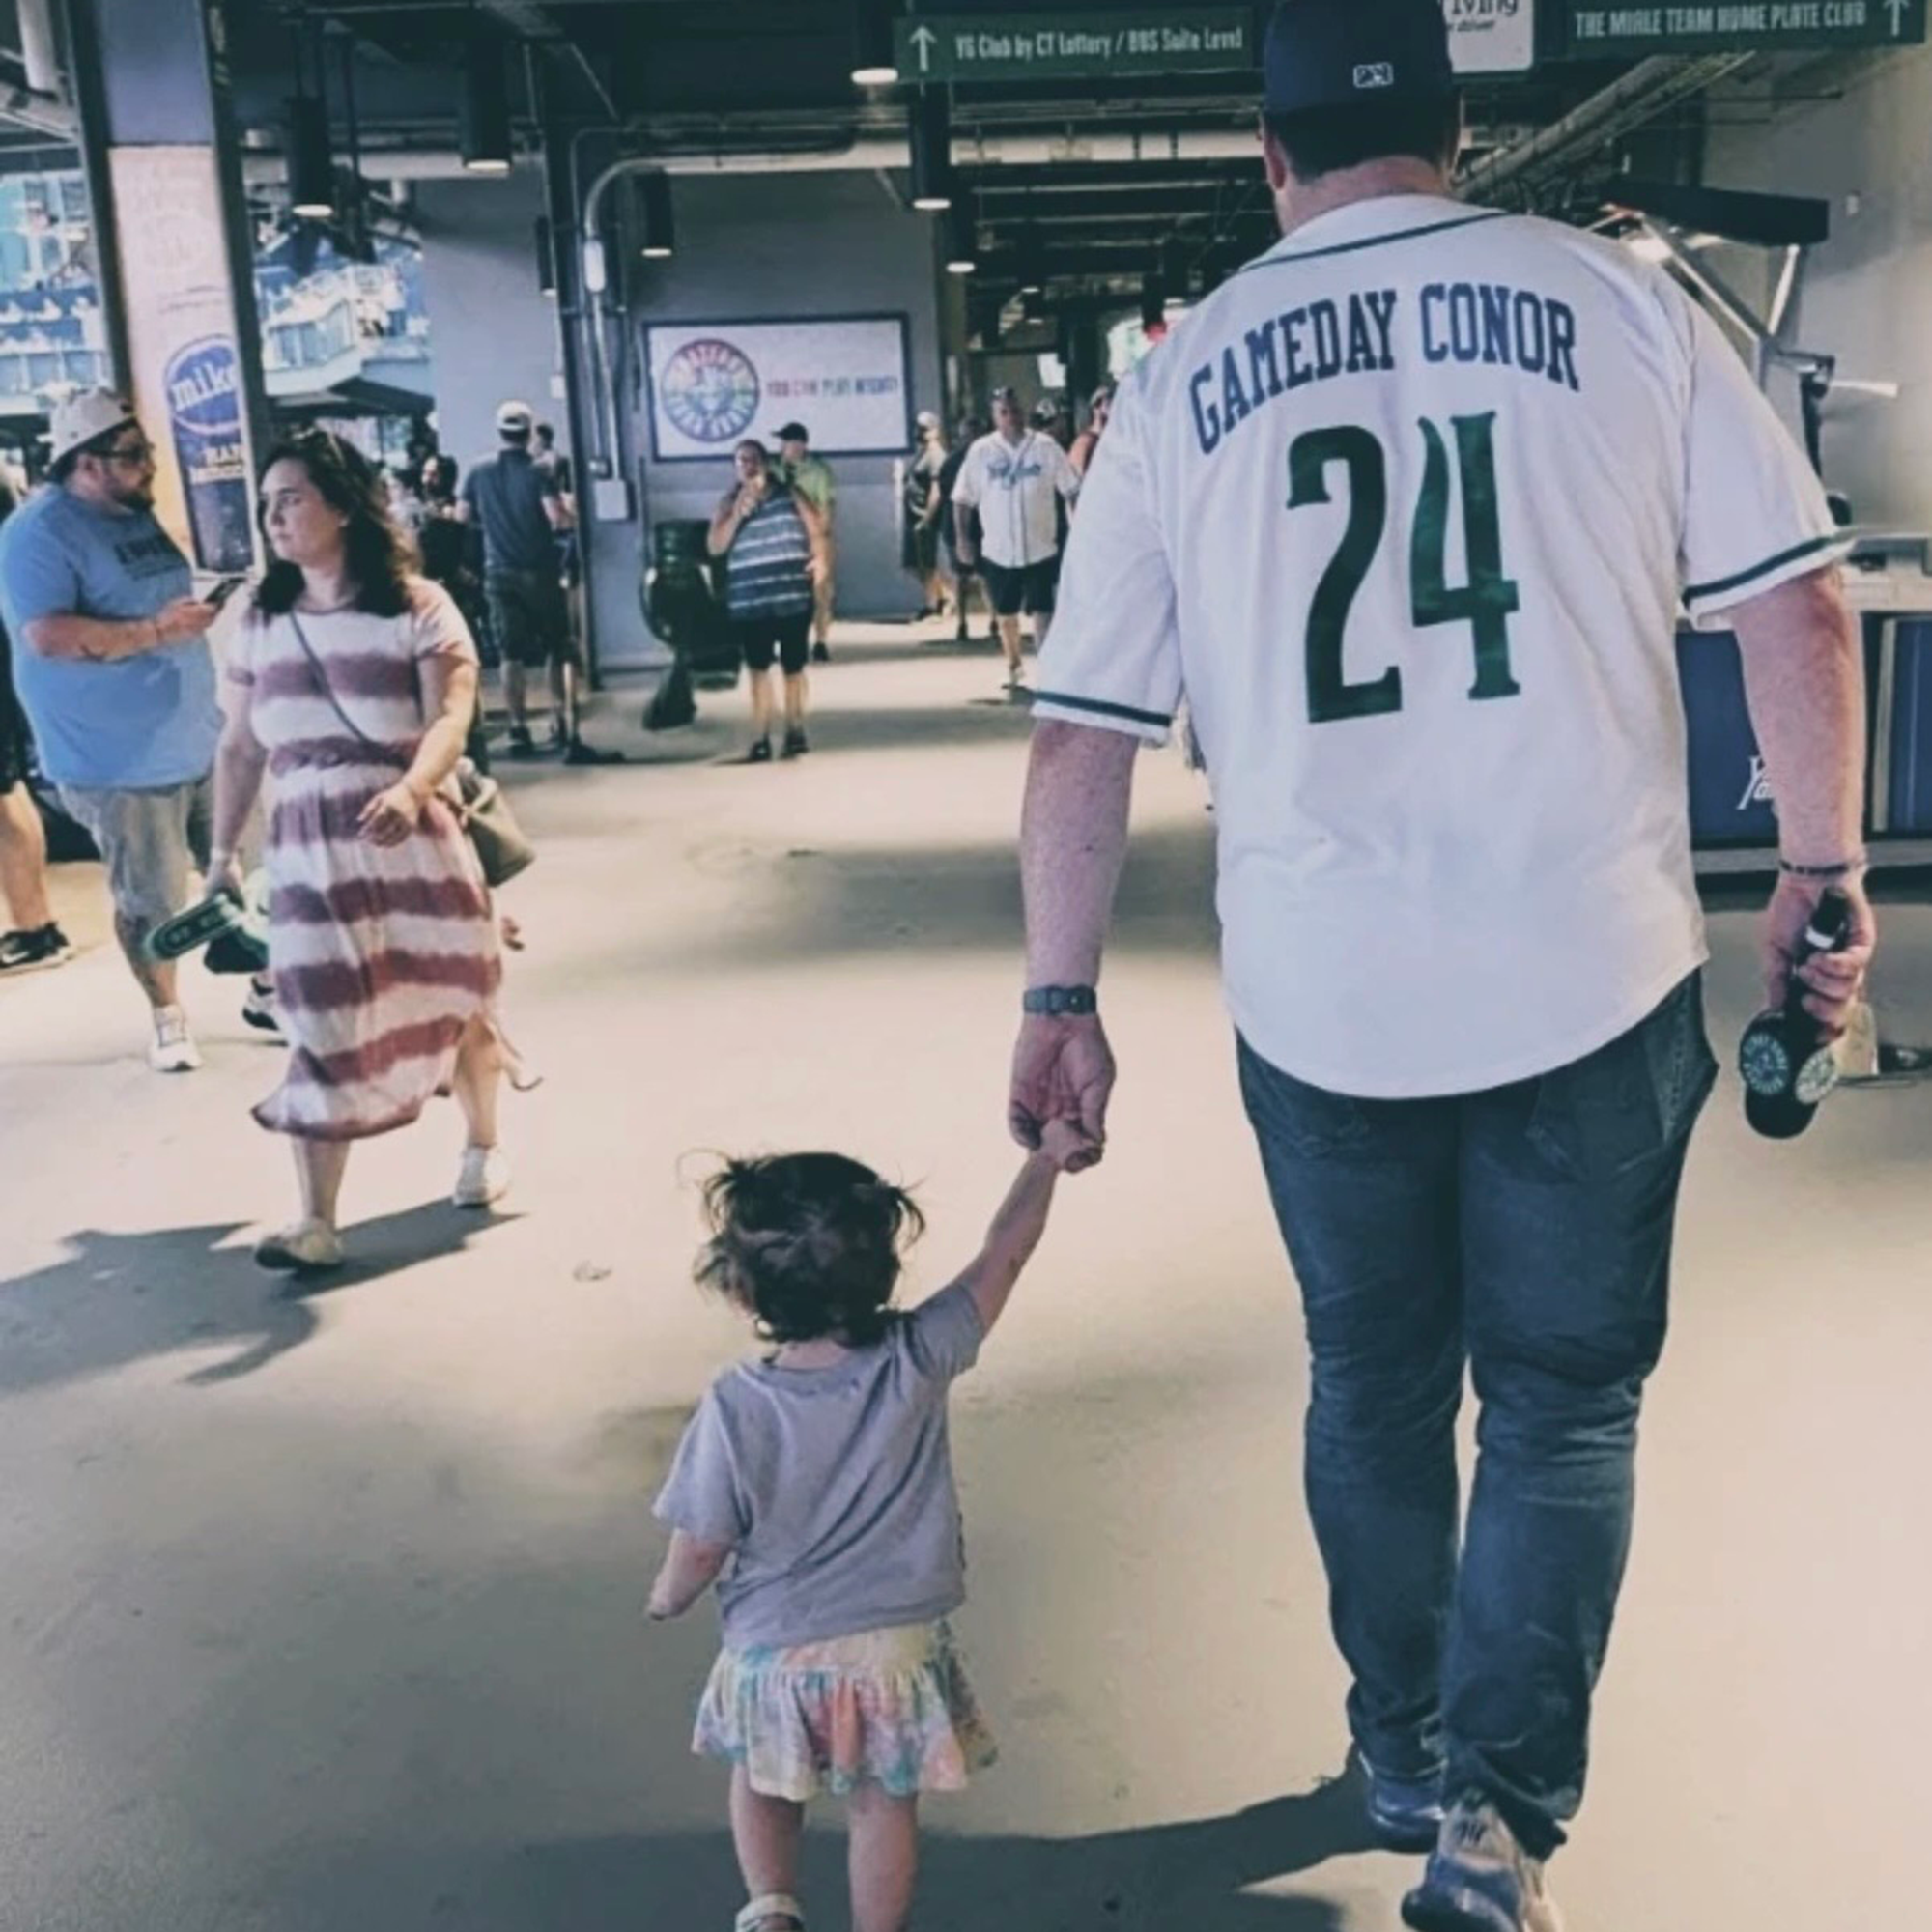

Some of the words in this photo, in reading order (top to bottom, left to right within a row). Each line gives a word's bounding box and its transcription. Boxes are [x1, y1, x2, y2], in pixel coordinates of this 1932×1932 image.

[979, 32, 1011, 58] Club
[1015, 34, 1033, 61] by
[1205, 25, 1242, 50] Level
[1575, 11, 1605, 38] THE
[1666, 8, 1713, 34] TEAM
[1717, 5, 1766, 32] HOME
[1770, 3, 1819, 30] PLATE
[1824, 1, 1866, 27] CLUB
[1189, 289, 1398, 455] GAMEDAY
[1420, 283, 1580, 391] CONOR
[1286, 409, 1521, 724] 24
